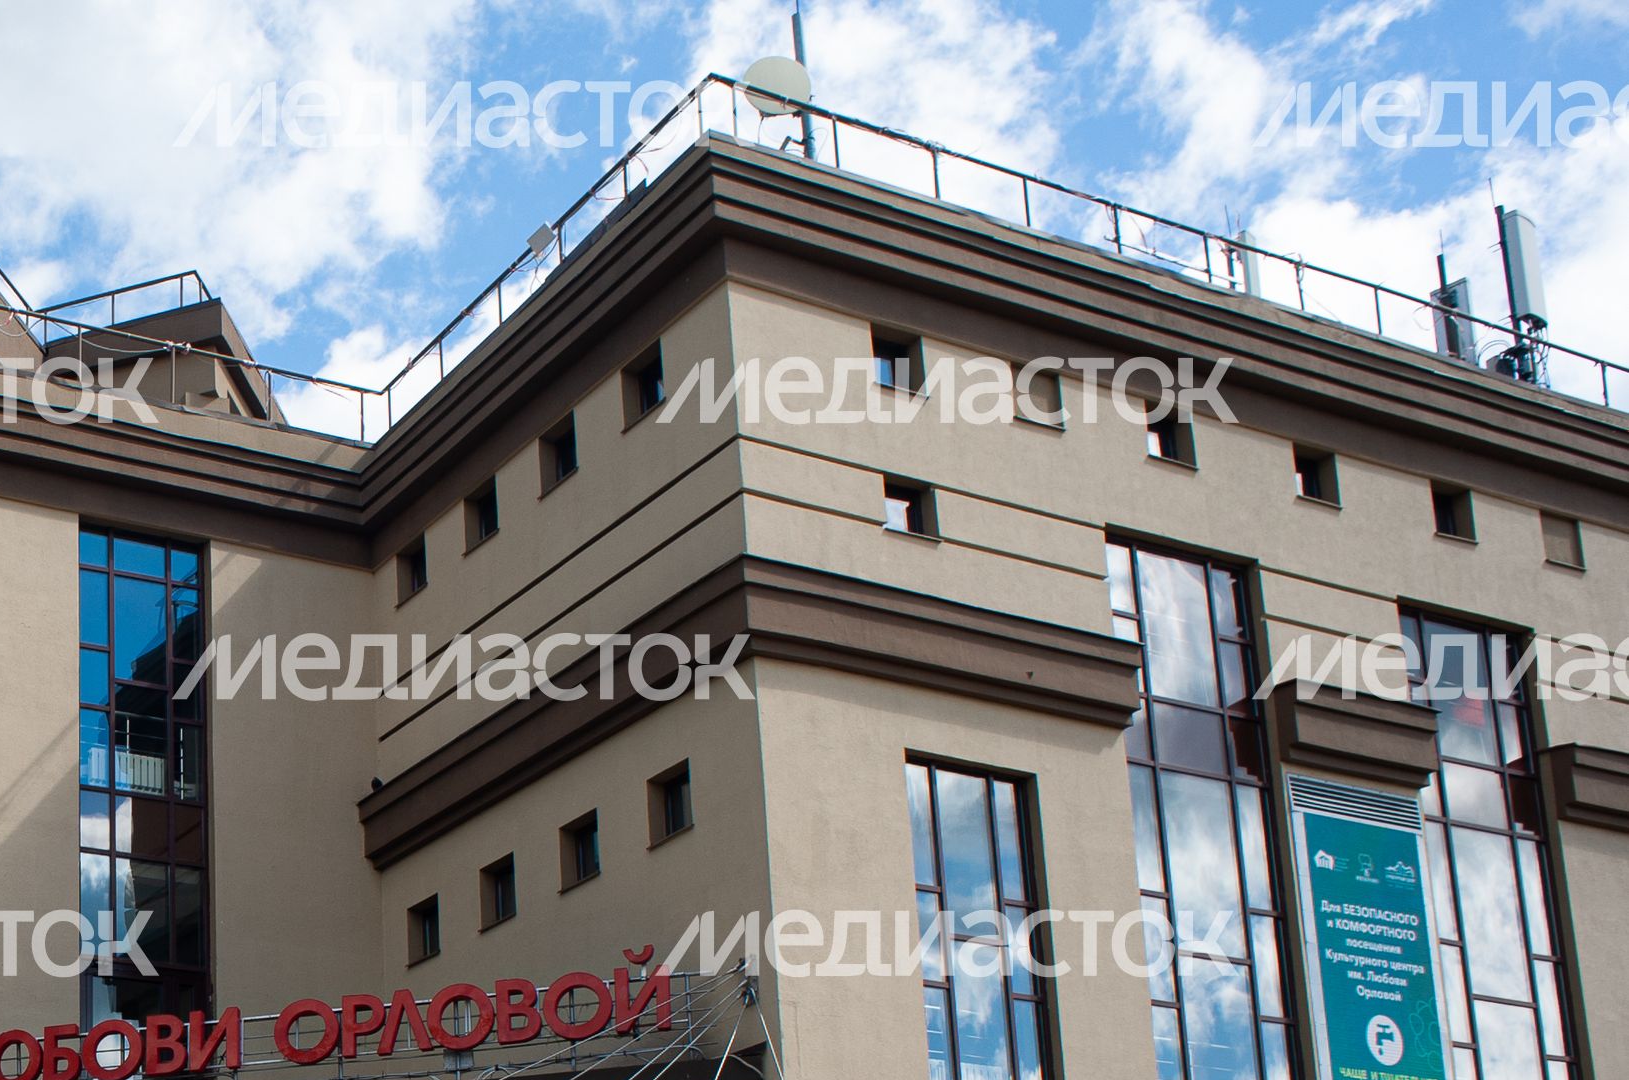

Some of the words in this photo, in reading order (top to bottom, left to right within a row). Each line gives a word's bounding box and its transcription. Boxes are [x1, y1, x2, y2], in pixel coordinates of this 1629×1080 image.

[1343, 904, 1419, 926] БЕЗОПАСНОГО
[1336, 919, 1417, 941] КОМФОРТНОГО
[1346, 939, 1402, 954] посещения
[1325, 948, 1388, 968] Культурного
[1367, 971, 1408, 986] Любови
[1356, 985, 1403, 1002] Орловой
[274, 944, 671, 1065] ОРЛОВОЙ
